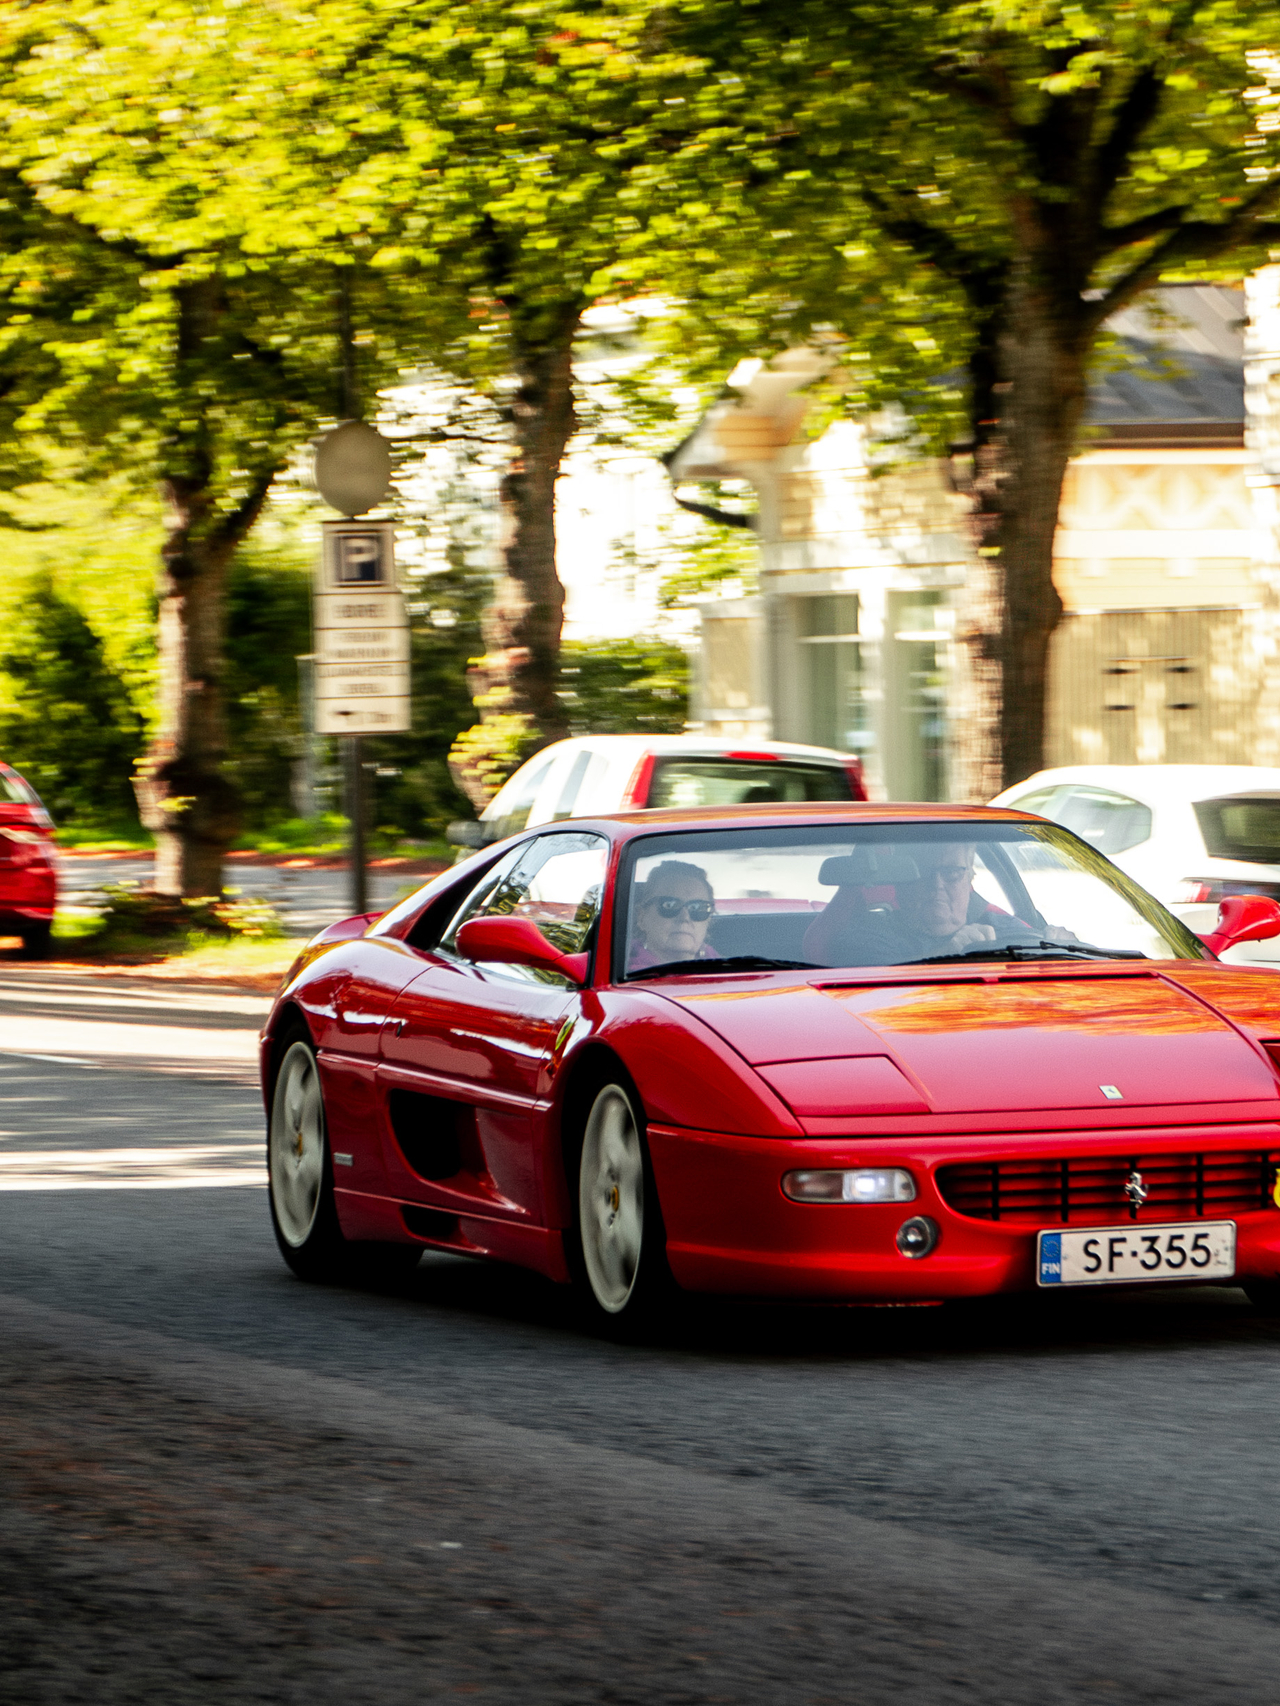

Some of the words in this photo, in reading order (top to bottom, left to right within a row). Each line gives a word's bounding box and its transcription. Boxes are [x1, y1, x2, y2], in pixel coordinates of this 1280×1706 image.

[341, 537, 379, 580] P
[1041, 1262, 1061, 1275] FIN
[1083, 1232, 1211, 1273] SF-355
